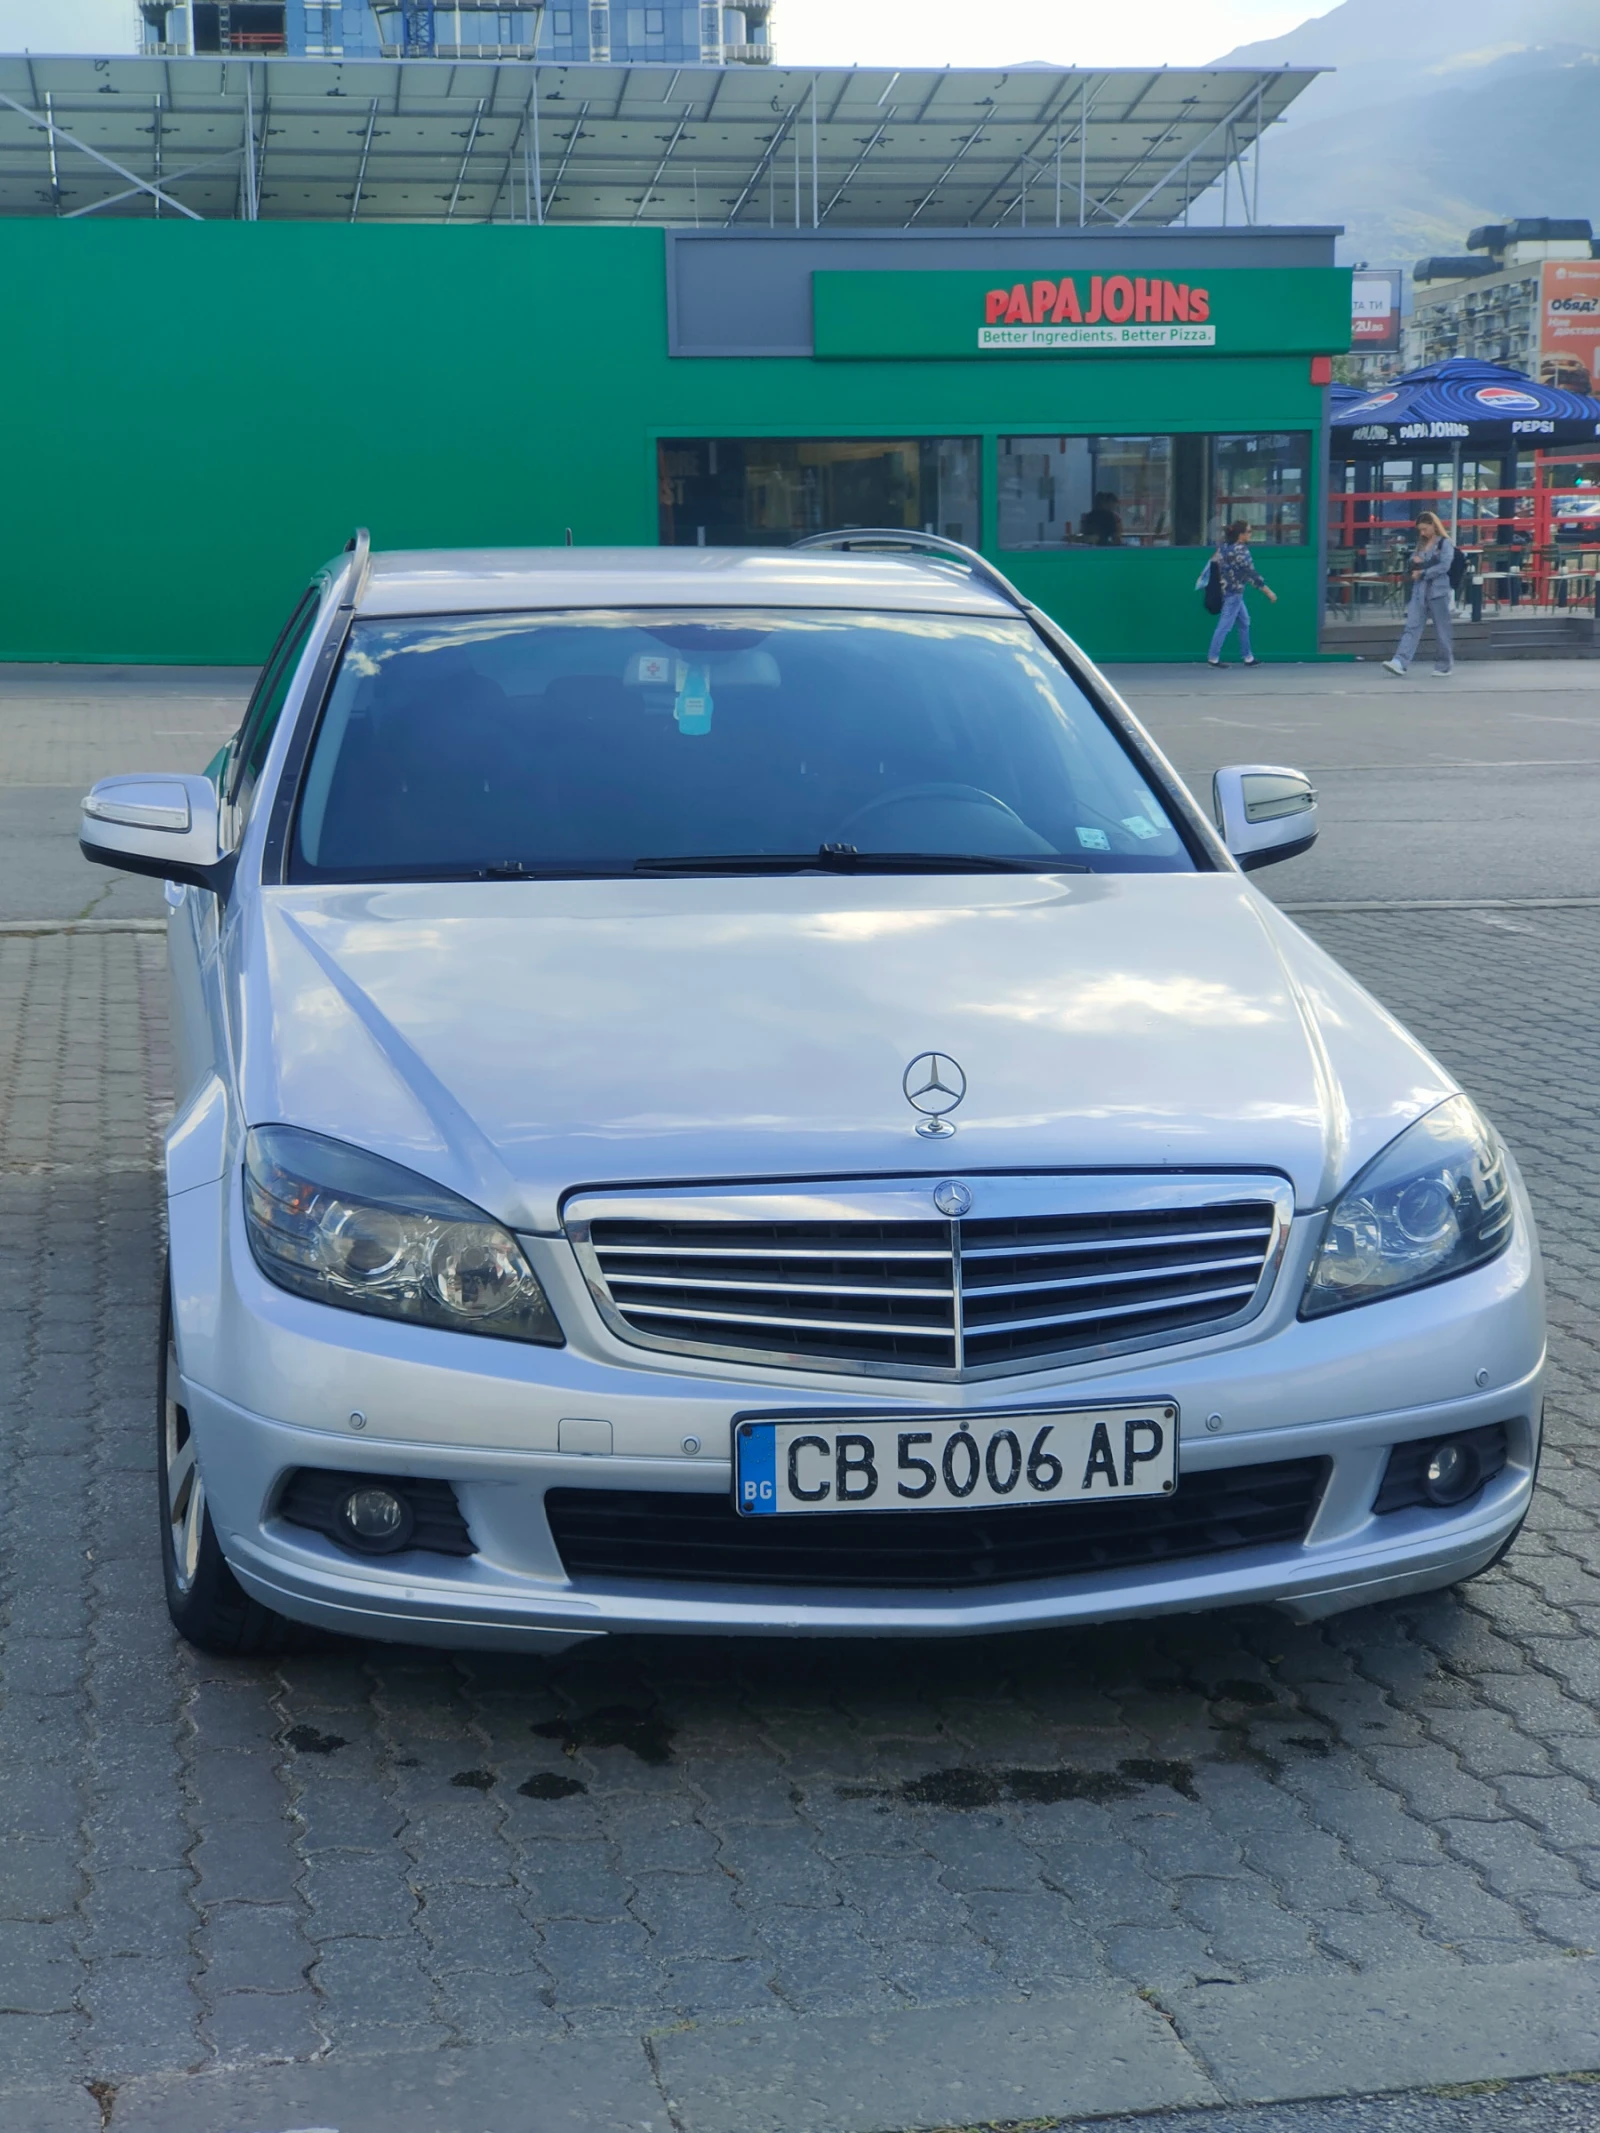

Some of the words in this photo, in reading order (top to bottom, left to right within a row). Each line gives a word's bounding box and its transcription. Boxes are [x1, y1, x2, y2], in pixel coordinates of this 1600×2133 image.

[985, 277, 1082, 324] PAPA
[1085, 275, 1210, 324] JOHNS
[1551, 298, 1599, 312] Обяд?
[983, 329, 1028, 344] Better
[1032, 328, 1118, 345] Ingredients.
[1121, 328, 1166, 342] Better
[1170, 327, 1212, 342] Pizza.
[1399, 423, 1428, 439] PAPA
[1430, 421, 1470, 438] JOHNS
[1512, 420, 1555, 434] PEPSI
[787, 1433, 879, 1503] CB
[897, 1425, 1064, 1500] 5006
[1081, 1419, 1164, 1490] AP
[743, 1480, 773, 1501] BG
